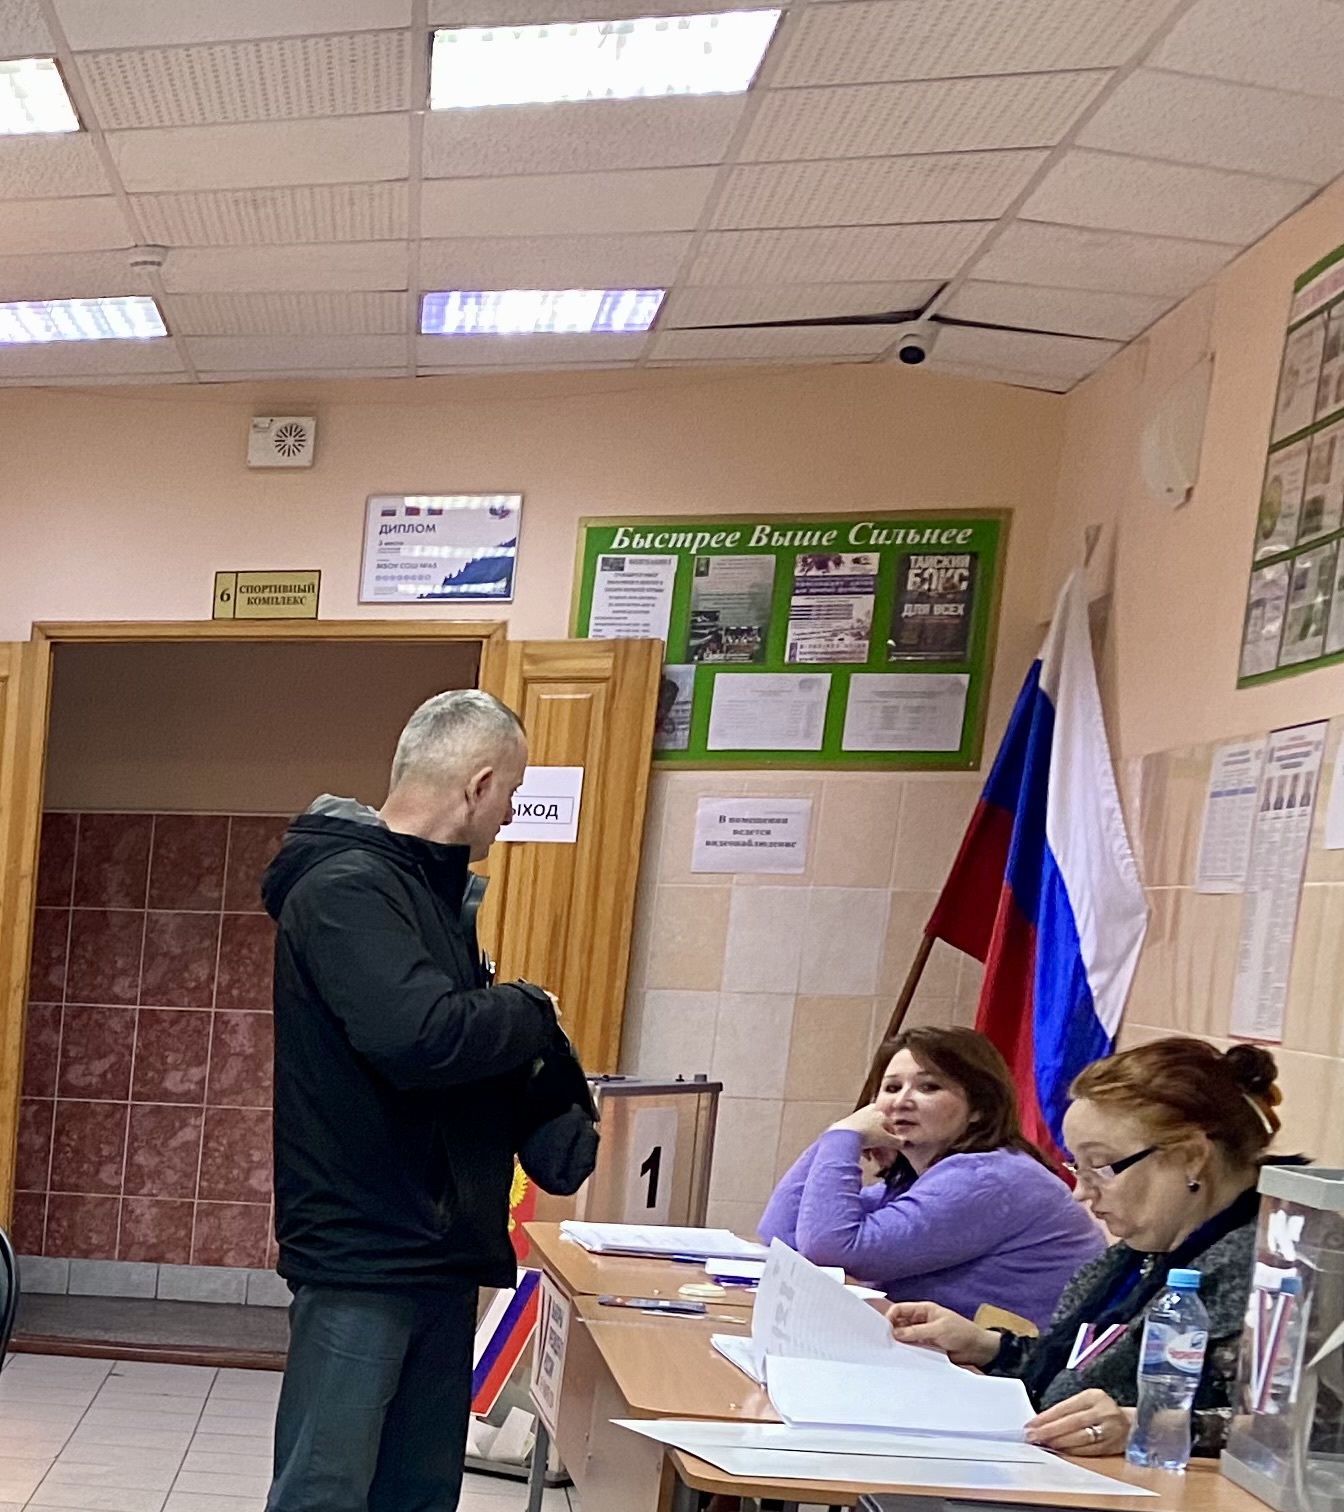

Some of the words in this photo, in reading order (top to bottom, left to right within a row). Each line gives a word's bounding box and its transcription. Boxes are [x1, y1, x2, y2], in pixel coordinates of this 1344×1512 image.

[378, 523, 437, 536] ДИПЛОМ
[610, 526, 741, 555] Быстрее
[749, 524, 838, 547] Выше
[848, 522, 974, 545] Сильнее
[905, 567, 970, 591] БОКС
[219, 587, 232, 603] 6
[238, 581, 317, 595] СПОРТИВНЫЙ
[246, 595, 307, 607] КОМПЛЕКС
[933, 603, 965, 616] ВСЕХ
[512, 803, 559, 820] ЫХОД
[639, 1146, 662, 1209] 1
